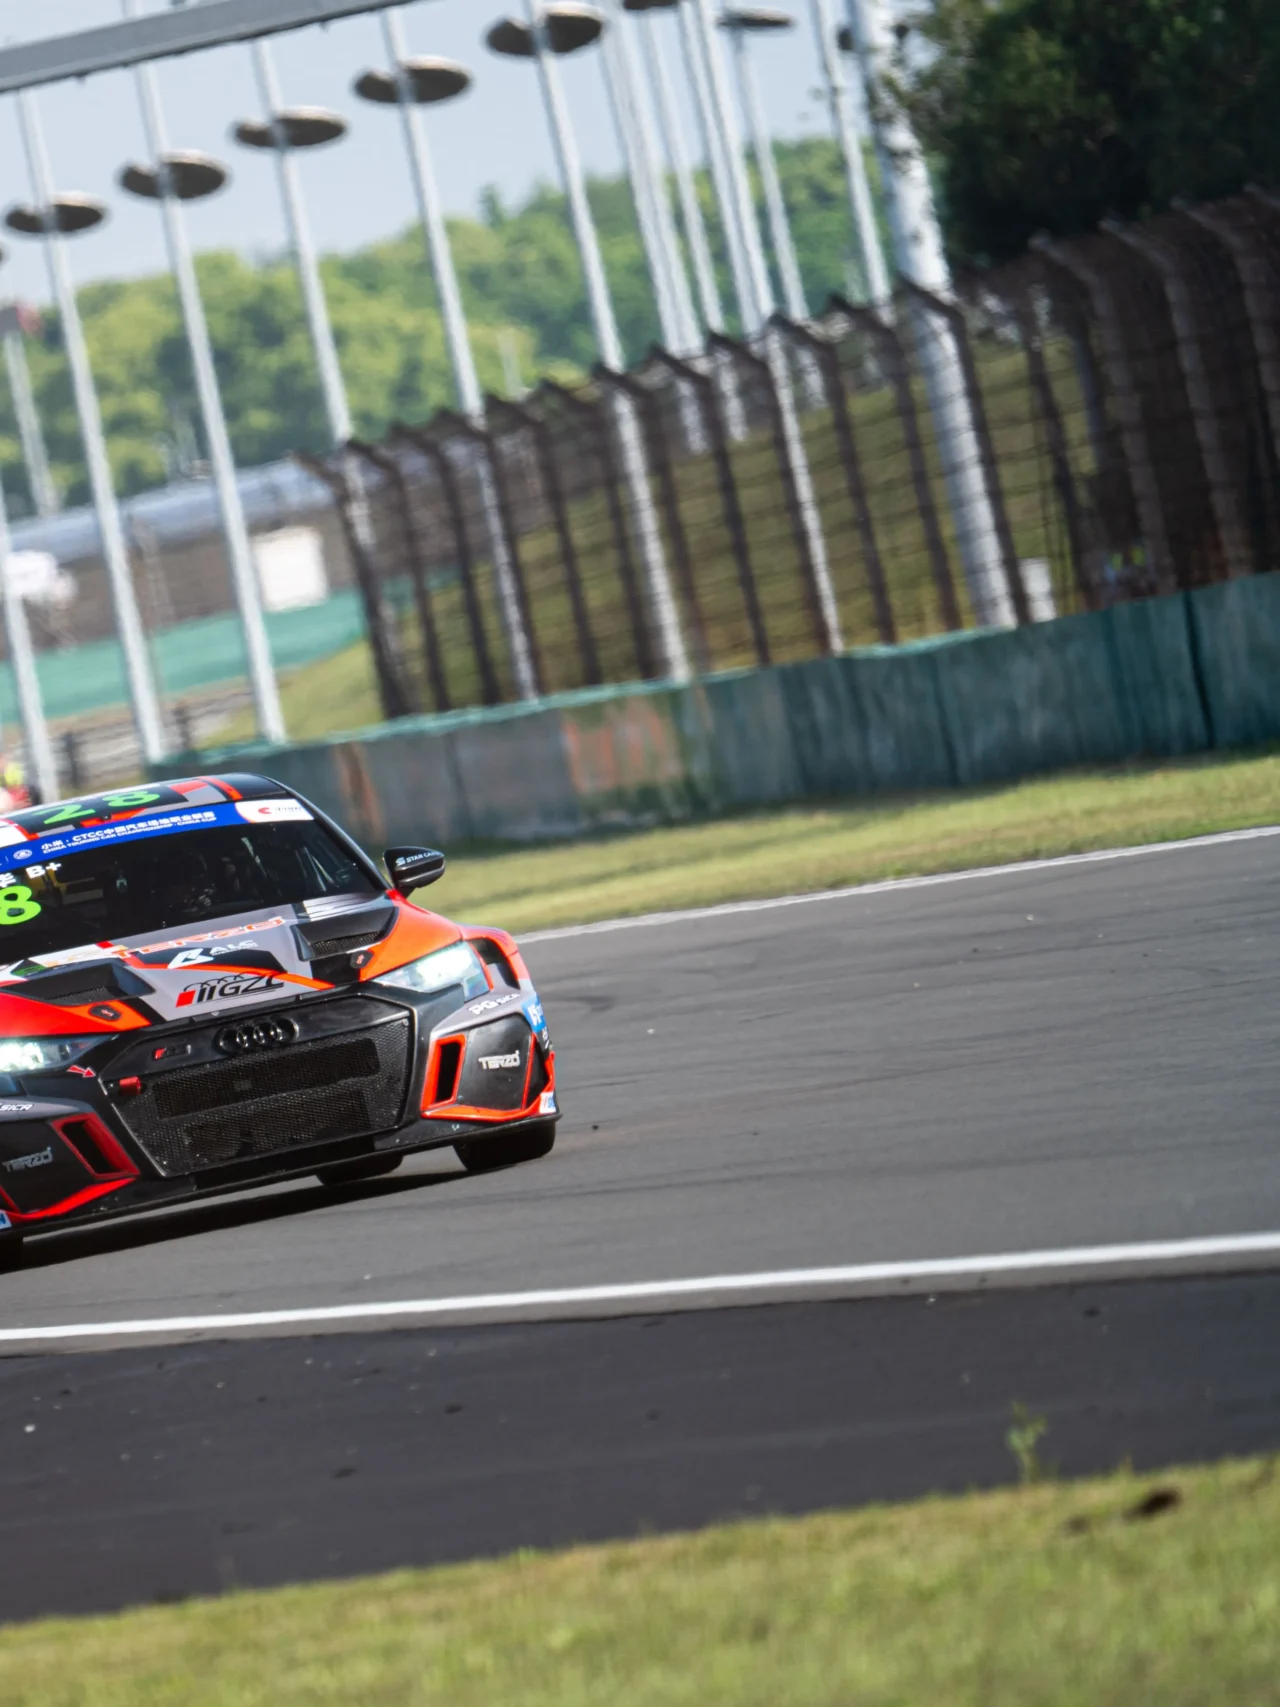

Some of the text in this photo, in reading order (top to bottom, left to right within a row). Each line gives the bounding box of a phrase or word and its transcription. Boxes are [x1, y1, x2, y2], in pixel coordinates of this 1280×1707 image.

[42, 844, 67, 853] CHINA
[26, 862, 62, 879] B+
[478, 1050, 520, 1070] TERZO
[2, 1146, 52, 1172] TERZO
